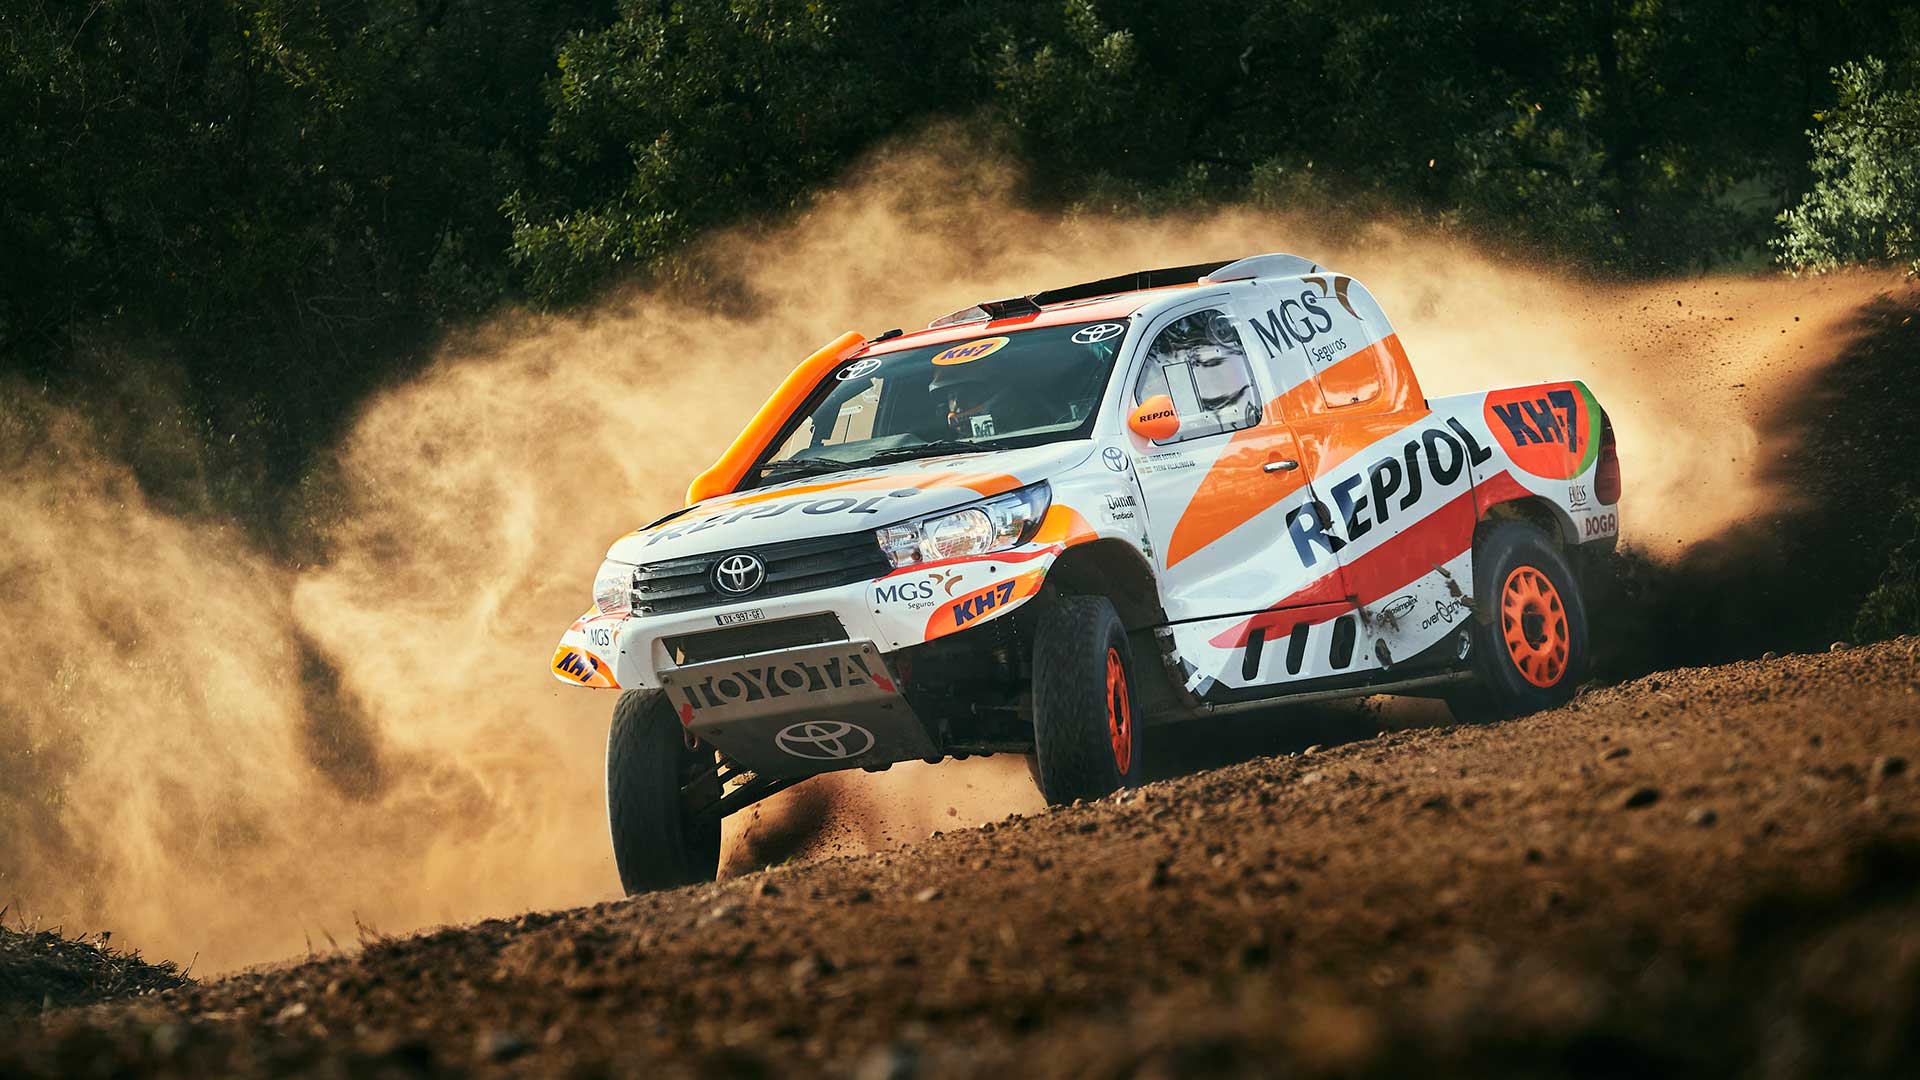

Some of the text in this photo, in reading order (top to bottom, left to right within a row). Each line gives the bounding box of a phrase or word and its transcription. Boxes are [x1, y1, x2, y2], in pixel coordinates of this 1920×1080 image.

[1248, 290, 1333, 359] MGS
[1311, 337, 1347, 362] Seguros
[1138, 409, 1175, 423] REPSOL
[1285, 416, 1492, 568] REPSOL
[643, 497, 887, 547] REPSOL
[1585, 513, 1616, 536] DOGA
[875, 580, 934, 604] MGS
[907, 600, 935, 610] Seguros
[590, 628, 610, 646] MGS
[682, 653, 873, 710] TOYOTA
